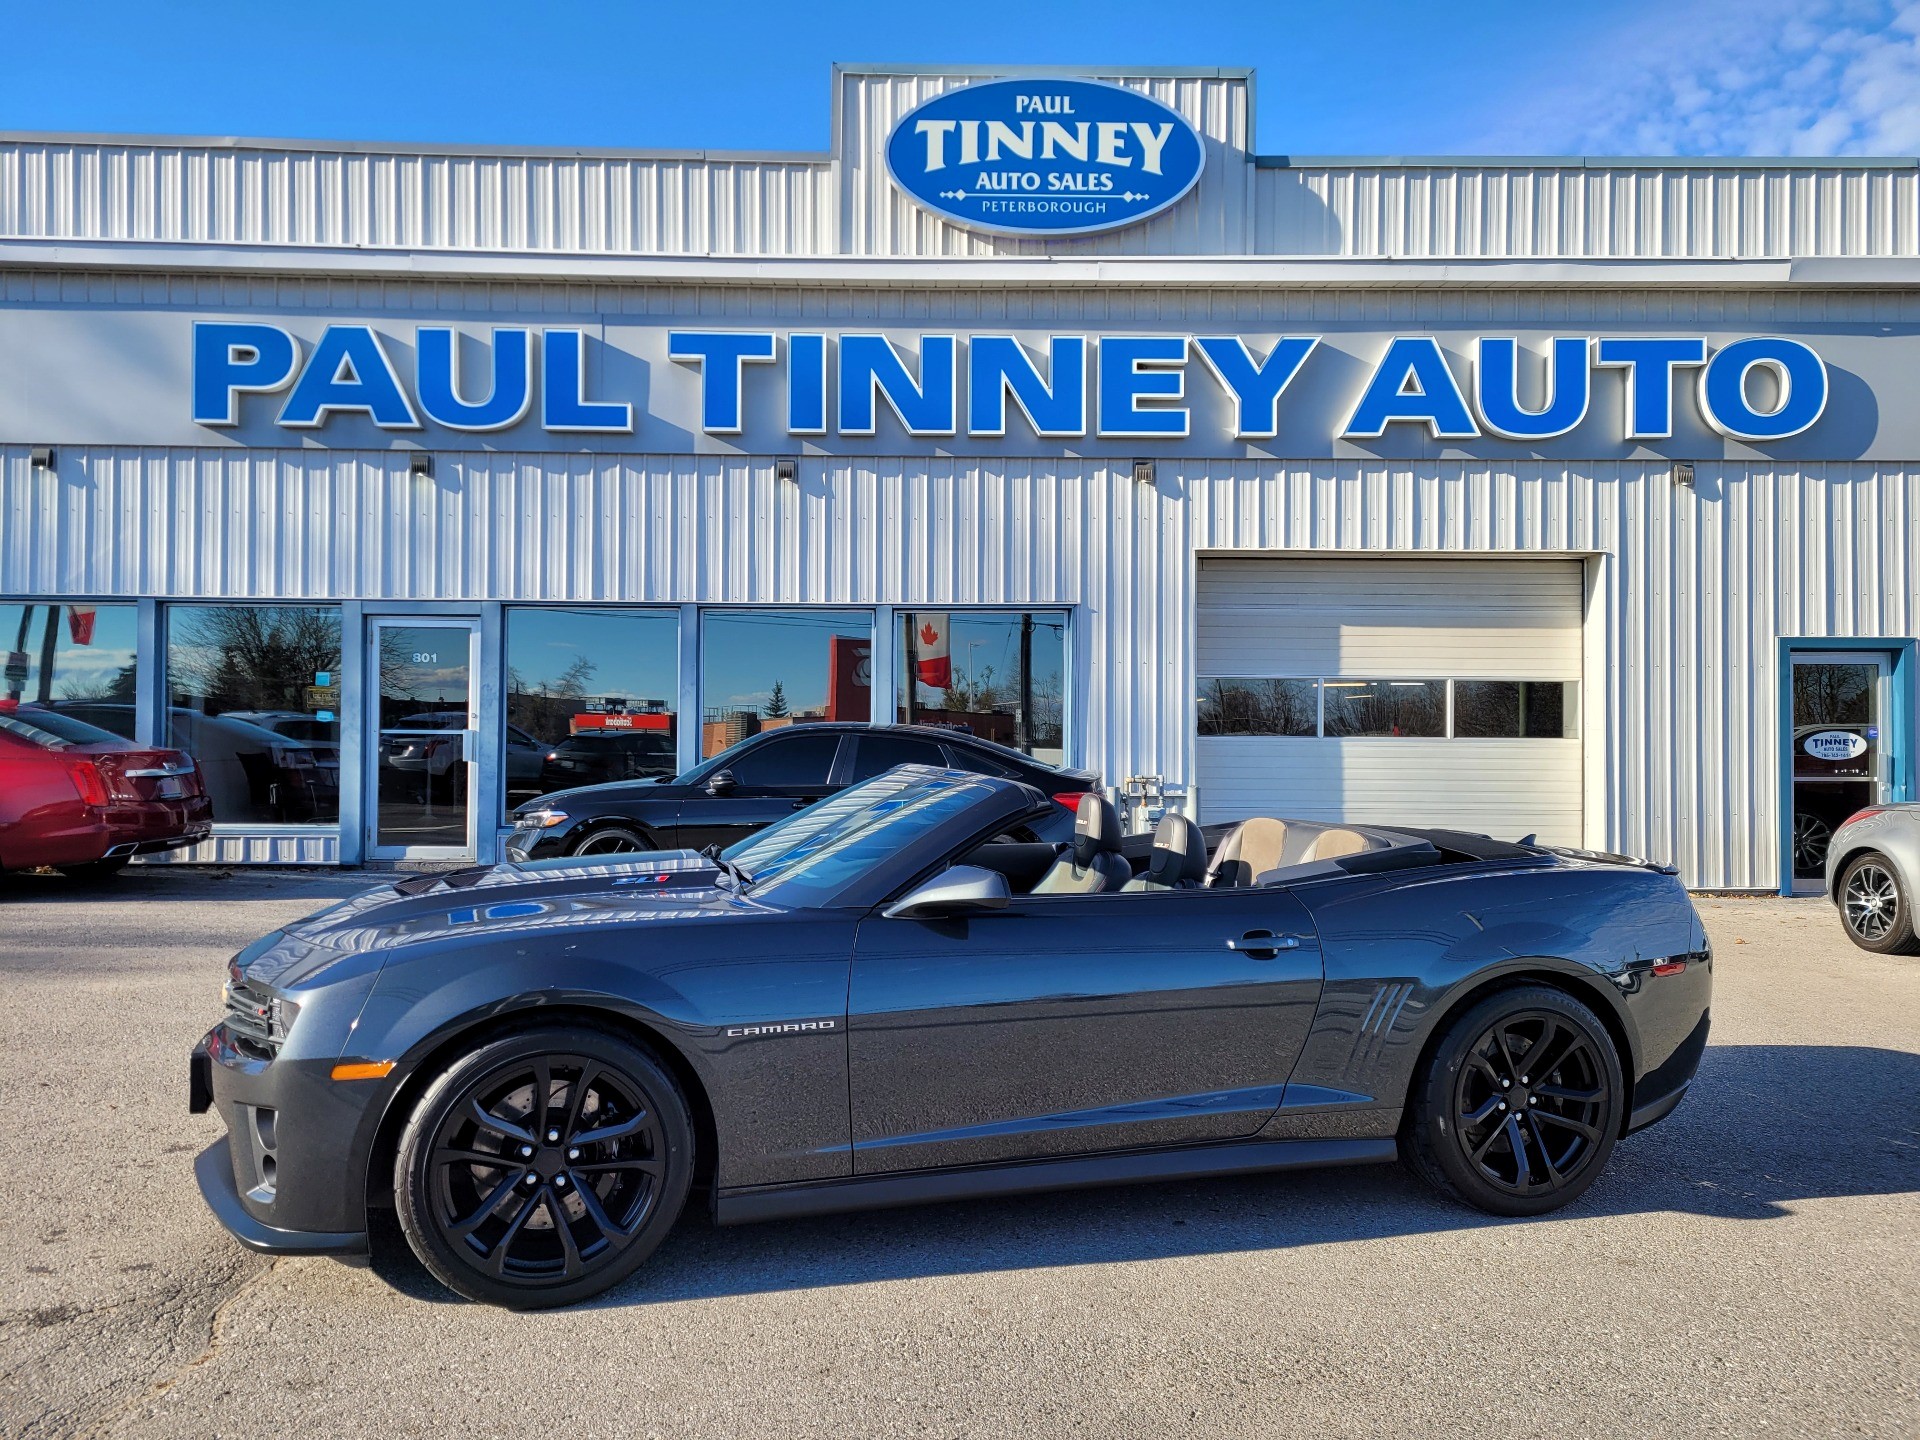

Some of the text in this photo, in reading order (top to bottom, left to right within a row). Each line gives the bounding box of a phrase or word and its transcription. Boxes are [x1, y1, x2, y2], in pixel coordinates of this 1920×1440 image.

[1016, 95, 1075, 114] PAUL
[914, 119, 1175, 176] TINNEY
[975, 171, 1114, 192] AUTO SALES
[982, 200, 1107, 214] PETERBOROUGH
[192, 320, 1829, 442] PAUL TINNEY AUTO
[412, 652, 437, 663] 801
[1812, 738, 1858, 749] TINNEY
[727, 1020, 835, 1037] CAMARO
